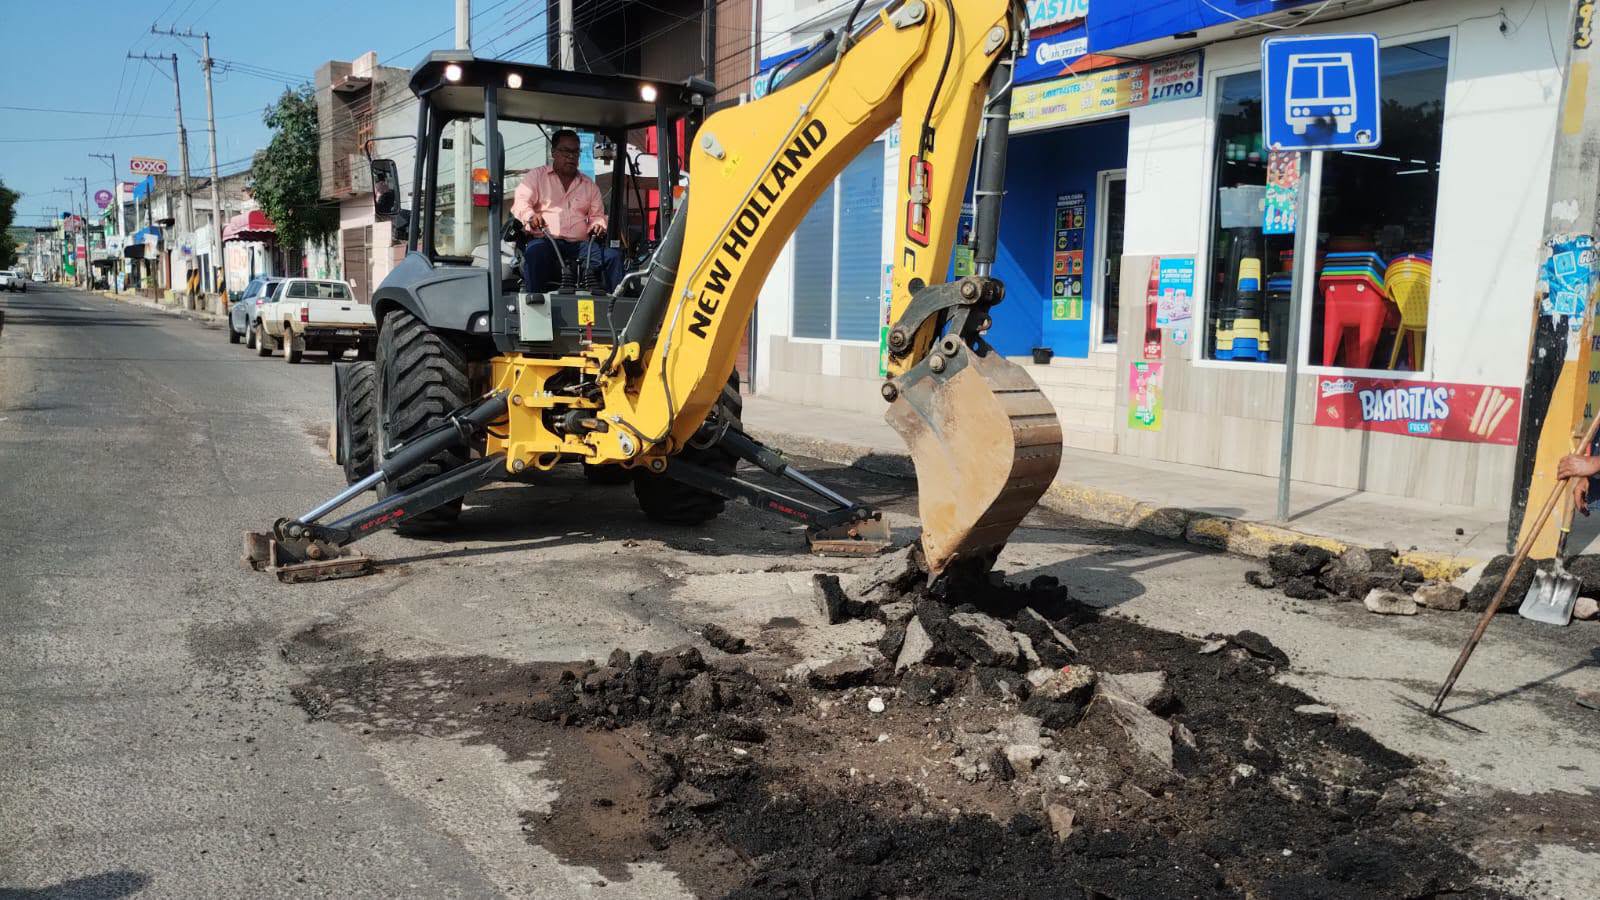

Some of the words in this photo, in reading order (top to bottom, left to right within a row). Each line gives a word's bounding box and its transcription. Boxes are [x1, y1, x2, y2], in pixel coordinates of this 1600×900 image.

[1152, 80, 1194, 100] LITRO
[131, 161, 167, 172] OXXO
[688, 259, 732, 340] NEW
[722, 118, 828, 261] HOLLAND
[1410, 422, 1430, 433] FRESA
